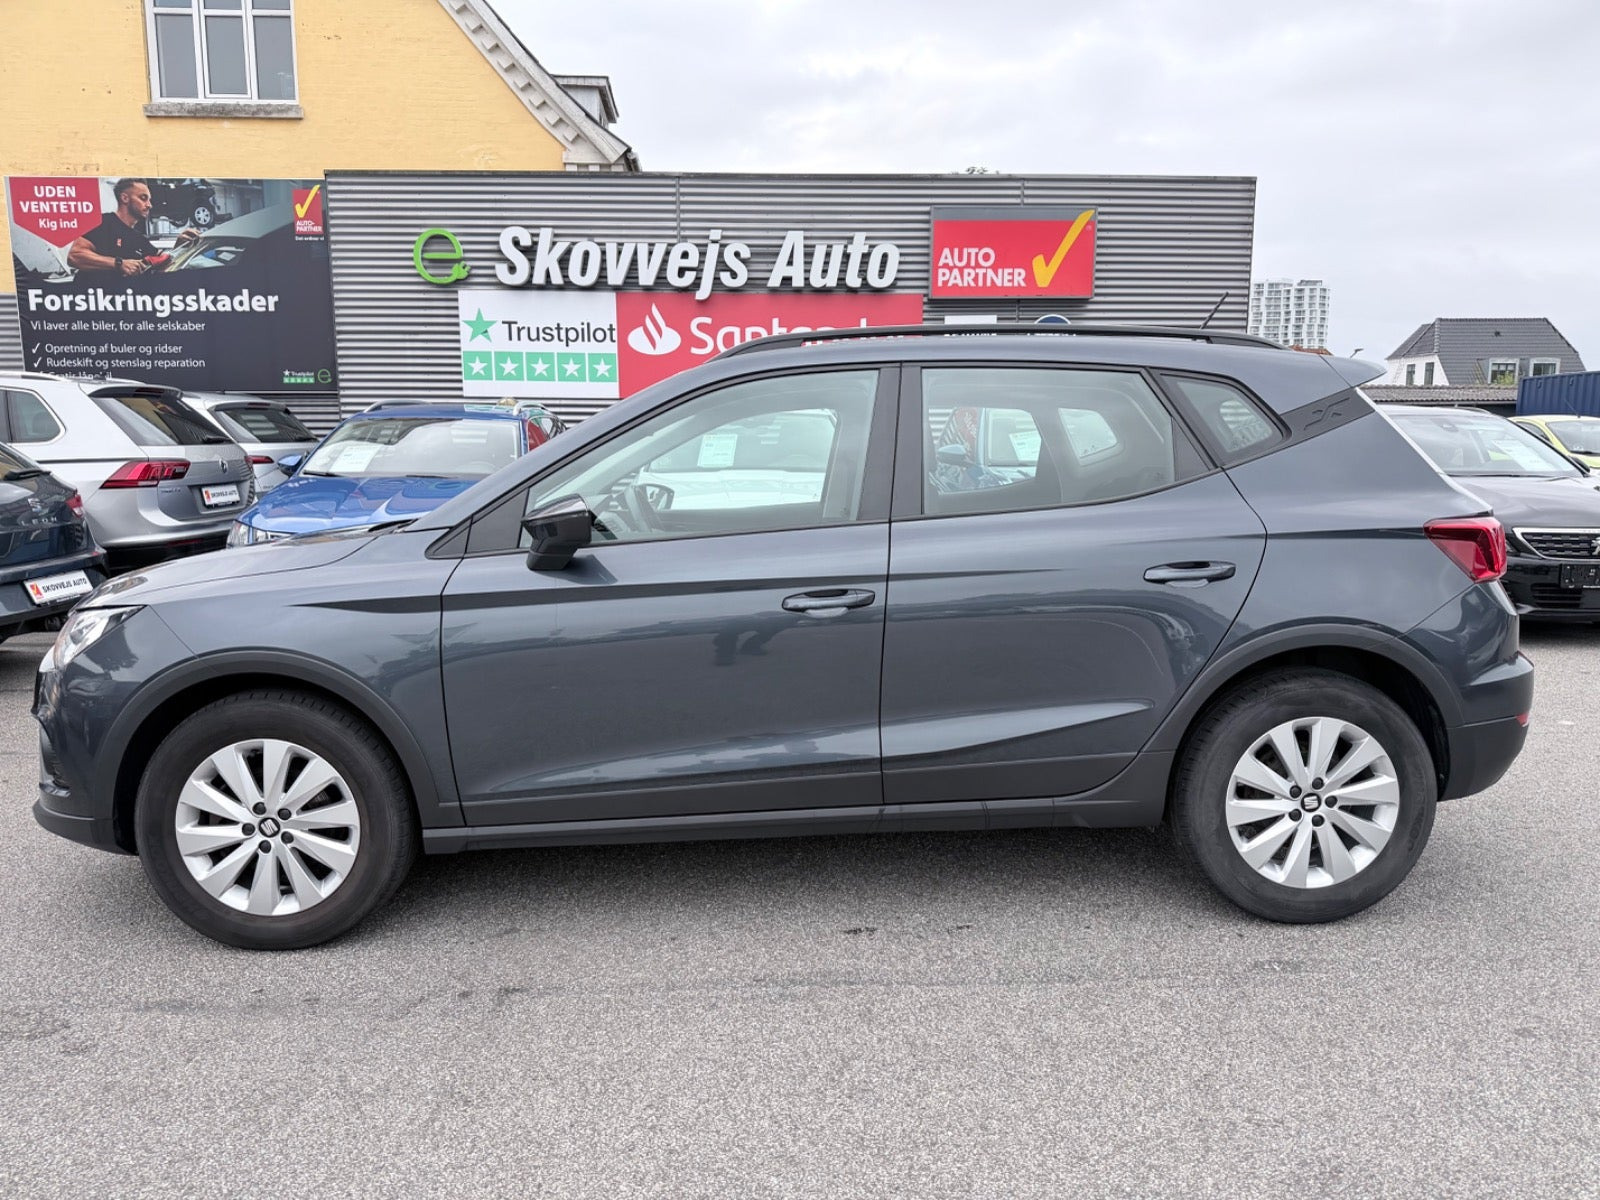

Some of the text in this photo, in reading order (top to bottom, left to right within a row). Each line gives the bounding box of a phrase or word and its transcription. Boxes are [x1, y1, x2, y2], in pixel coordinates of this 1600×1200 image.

[34, 186, 76, 198] UDEN
[20, 201, 94, 213] VENTETID
[39, 218, 78, 230] Kig ind
[495, 226, 901, 300] Skovvejs Auto
[938, 248, 996, 268] AUTO
[938, 268, 1026, 288] PARTNER
[28, 288, 278, 318] Forsikringsskader
[30, 320, 206, 332] Vi laver alle biler, for alle selskaber
[502, 320, 616, 346] Trustpilot
[45, 343, 182, 356] Opretning af buler og ridser
[46, 358, 206, 370] Rudeskift og stenslag reparation
[42, 577, 87, 593] SKOVVEJS AUTO
